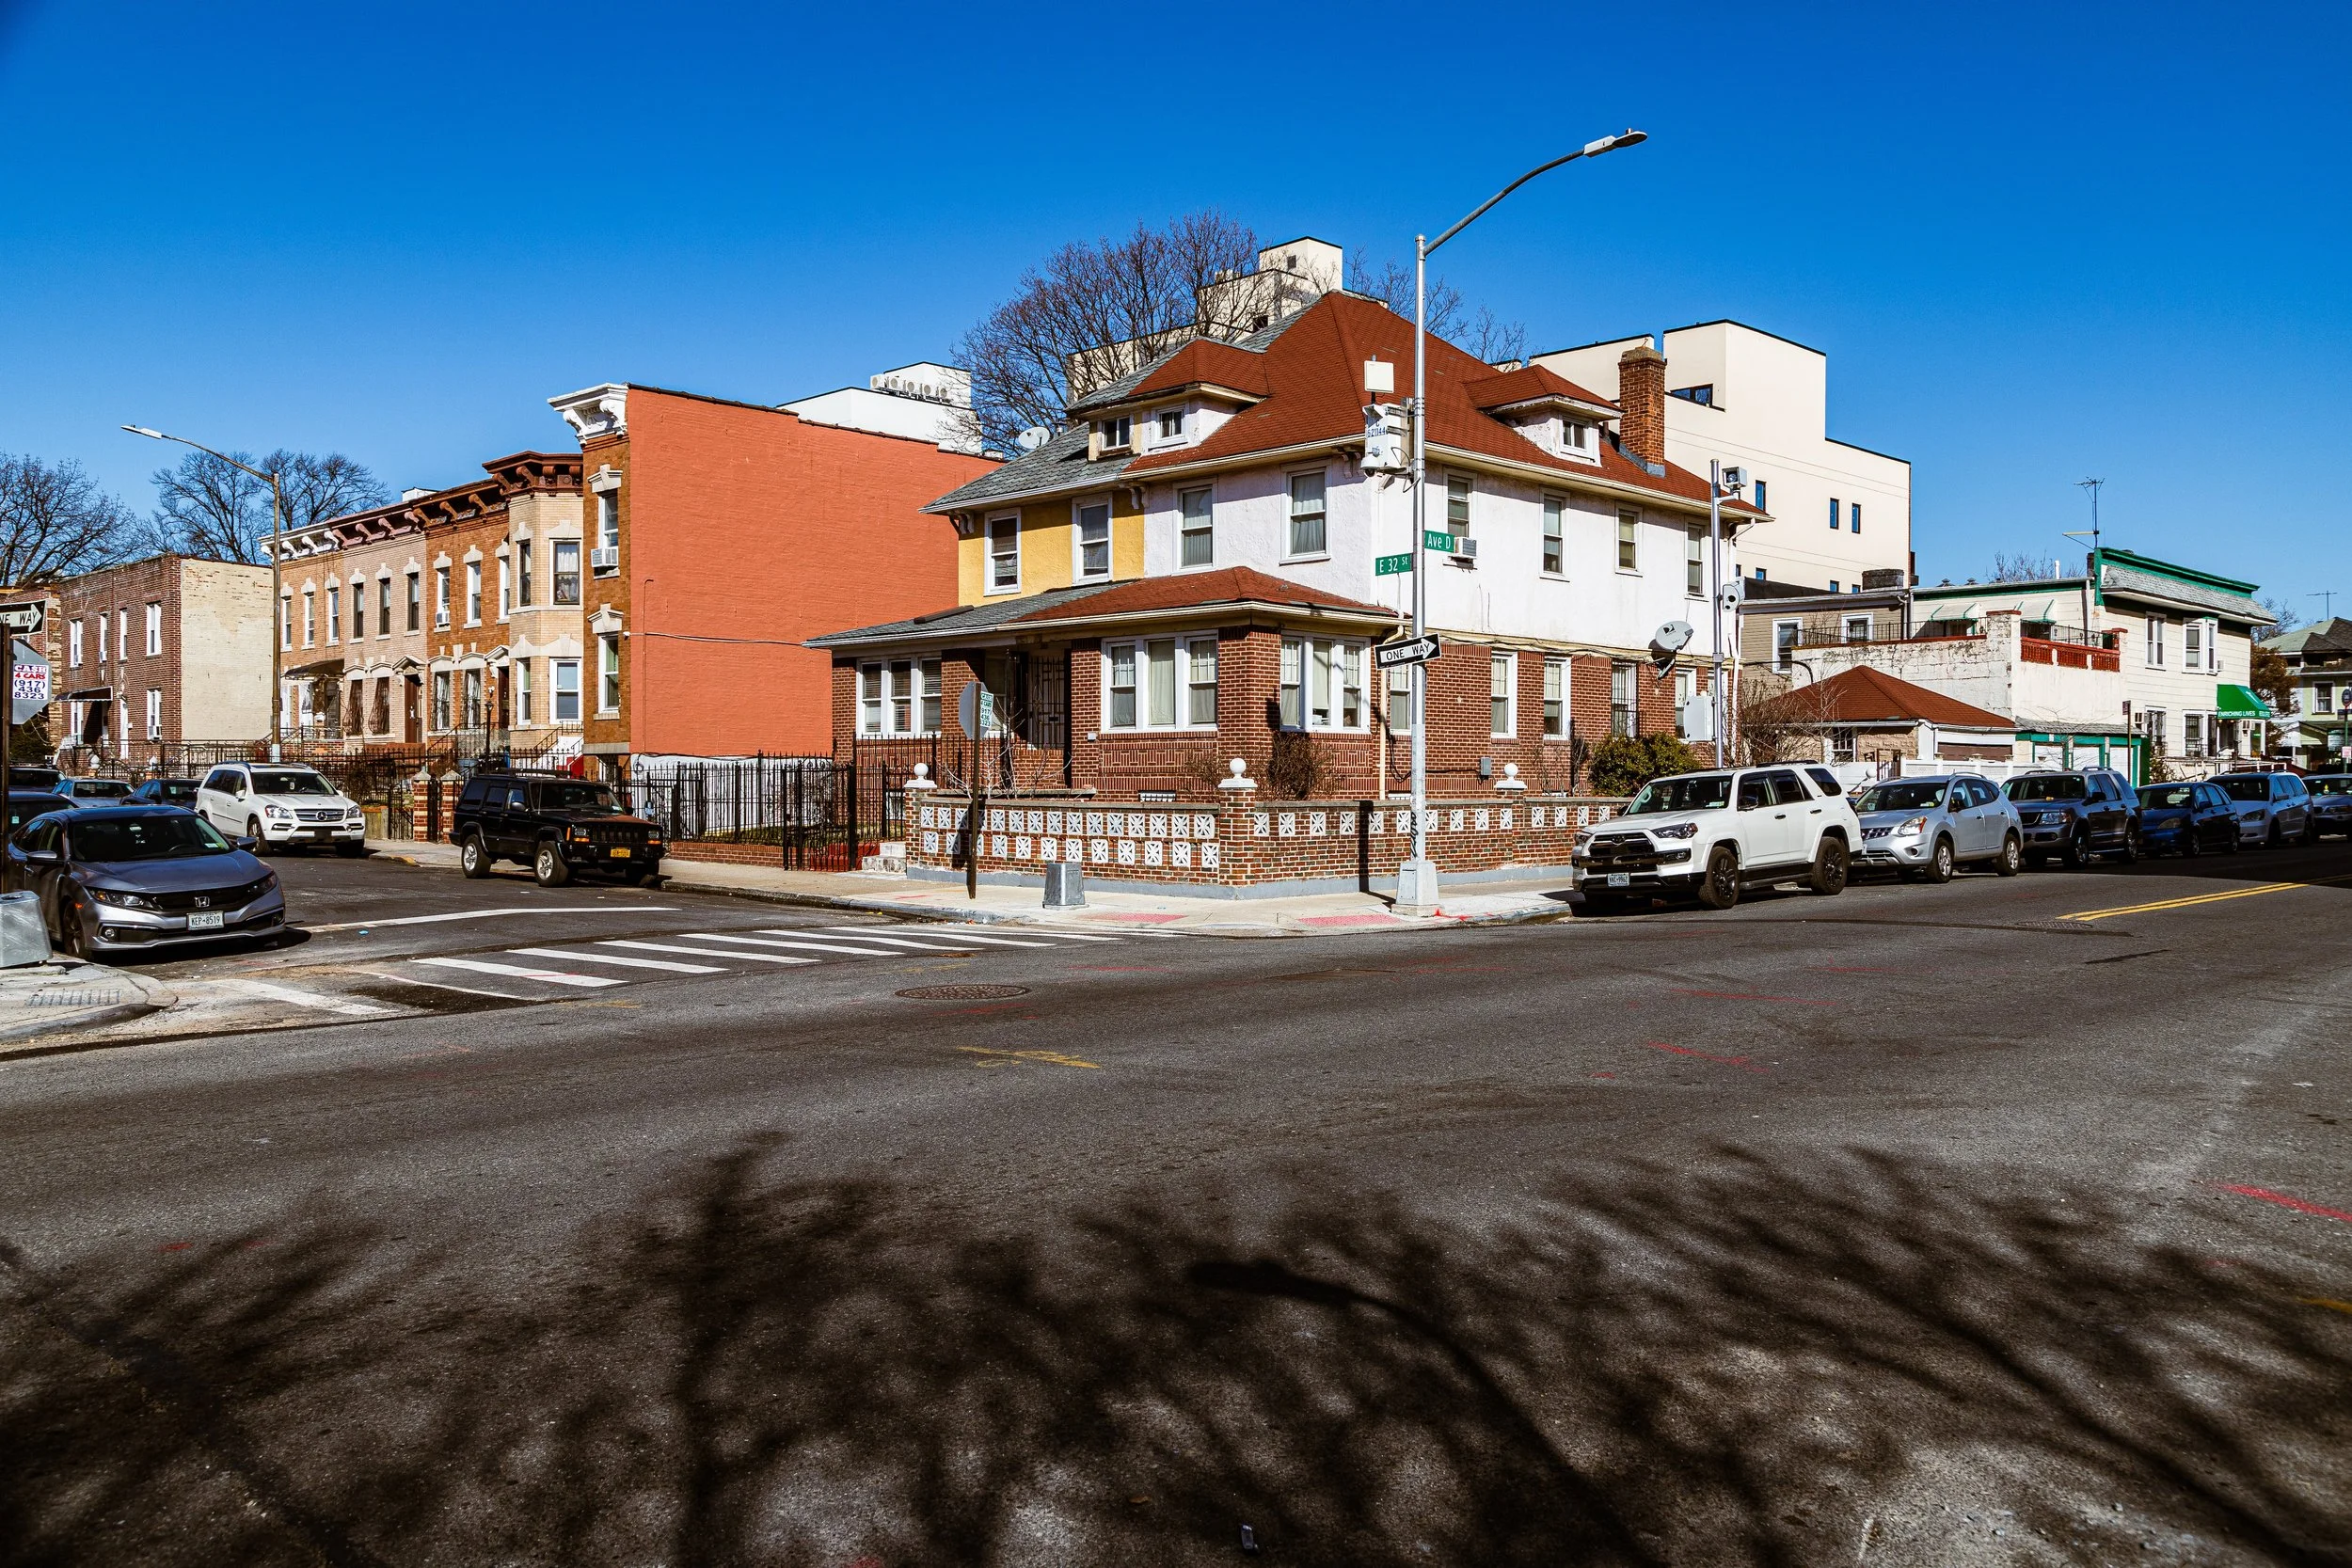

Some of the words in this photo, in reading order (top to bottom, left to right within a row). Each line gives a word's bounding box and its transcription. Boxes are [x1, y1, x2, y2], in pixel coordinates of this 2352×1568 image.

[1427, 533, 1442, 548] Ave
[1445, 535, 1451, 549] D
[1379, 560, 1384, 573] E
[1388, 557, 1398, 572] 32
[19, 611, 38, 625] WAY
[1386, 648, 1405, 660] ONE
[1411, 642, 1430, 656] WAY
[14, 665, 46, 673] CASH
[14, 680, 45, 689] (917)
